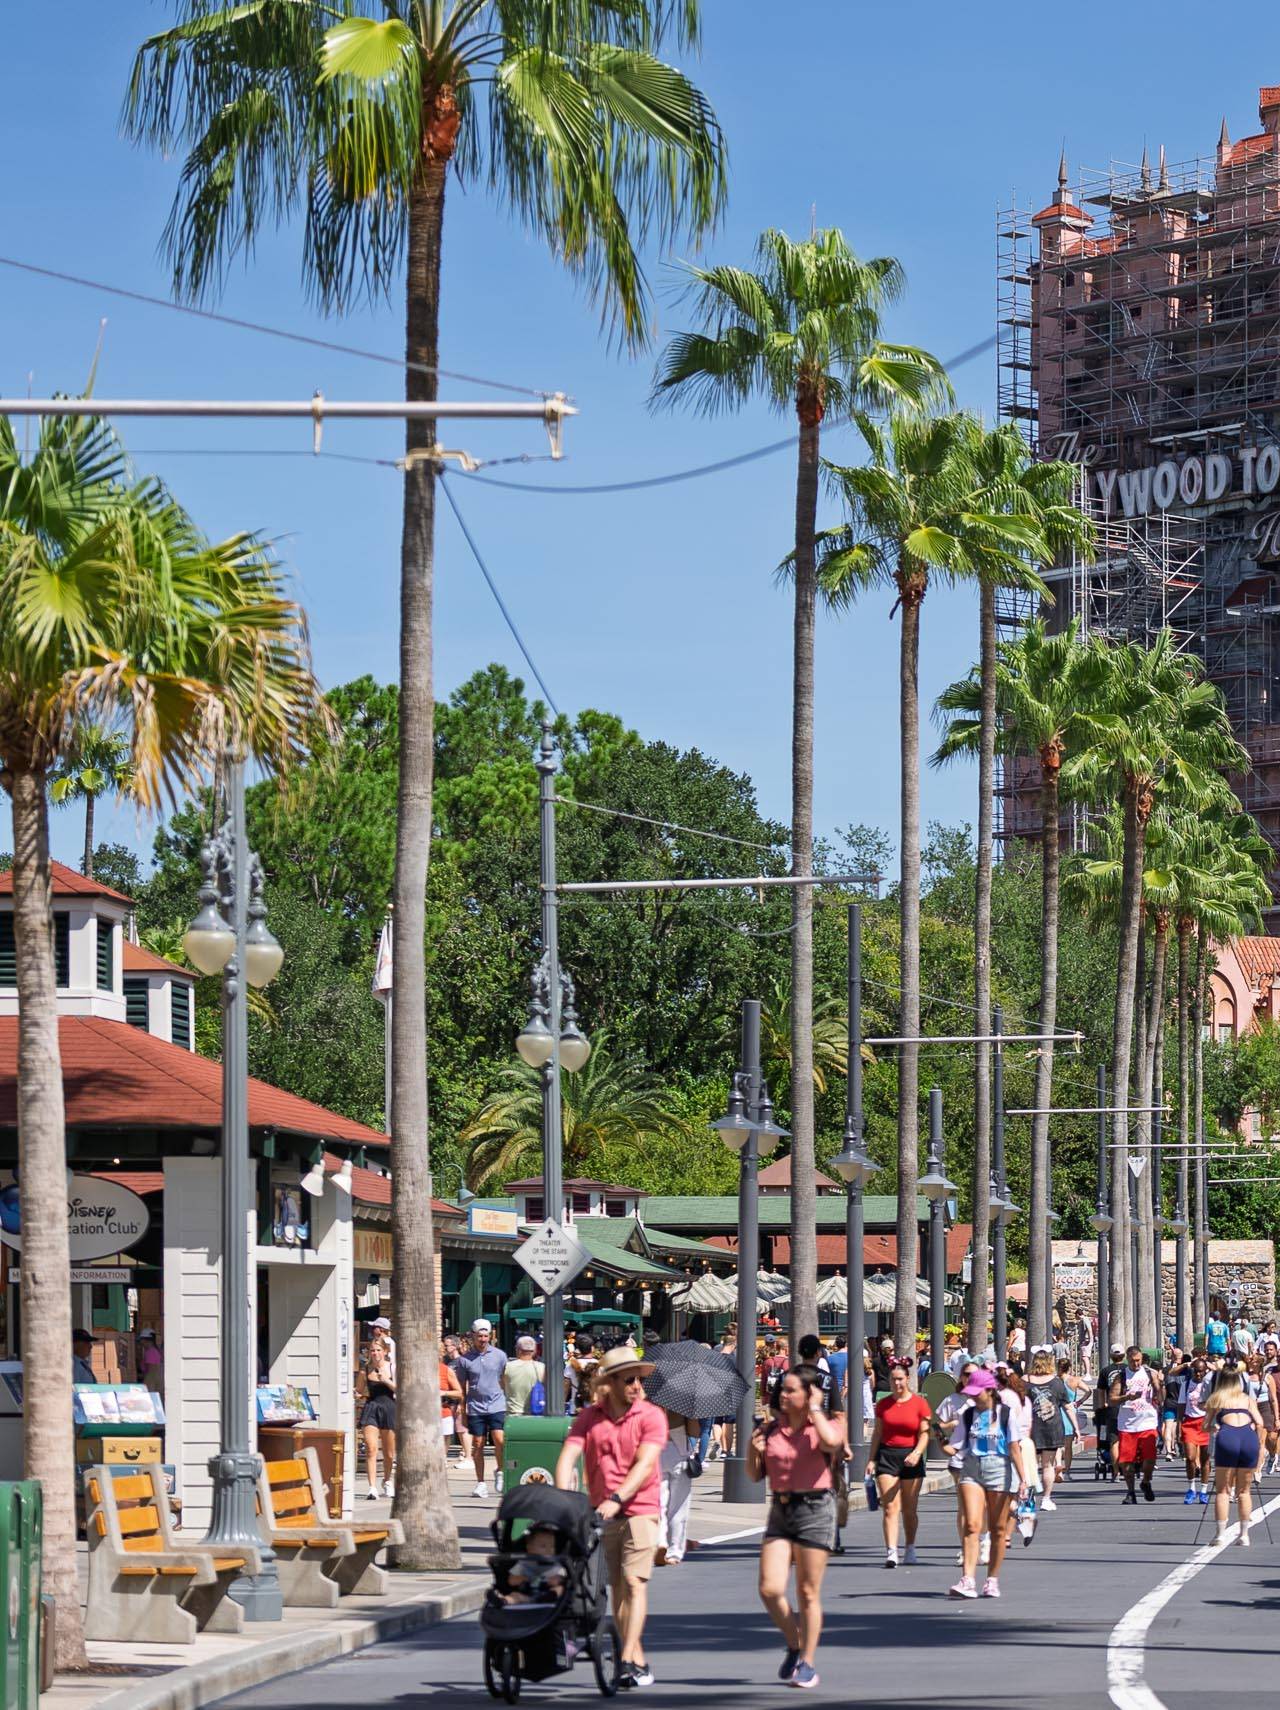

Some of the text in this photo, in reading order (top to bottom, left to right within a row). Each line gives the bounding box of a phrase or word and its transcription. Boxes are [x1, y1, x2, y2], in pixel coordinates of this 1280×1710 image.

[1042, 431, 1105, 465] The
[1096, 453, 1232, 518] YWOOD
[108, 1222, 138, 1234] Club
[71, 1271, 127, 1280] NFORMATION
